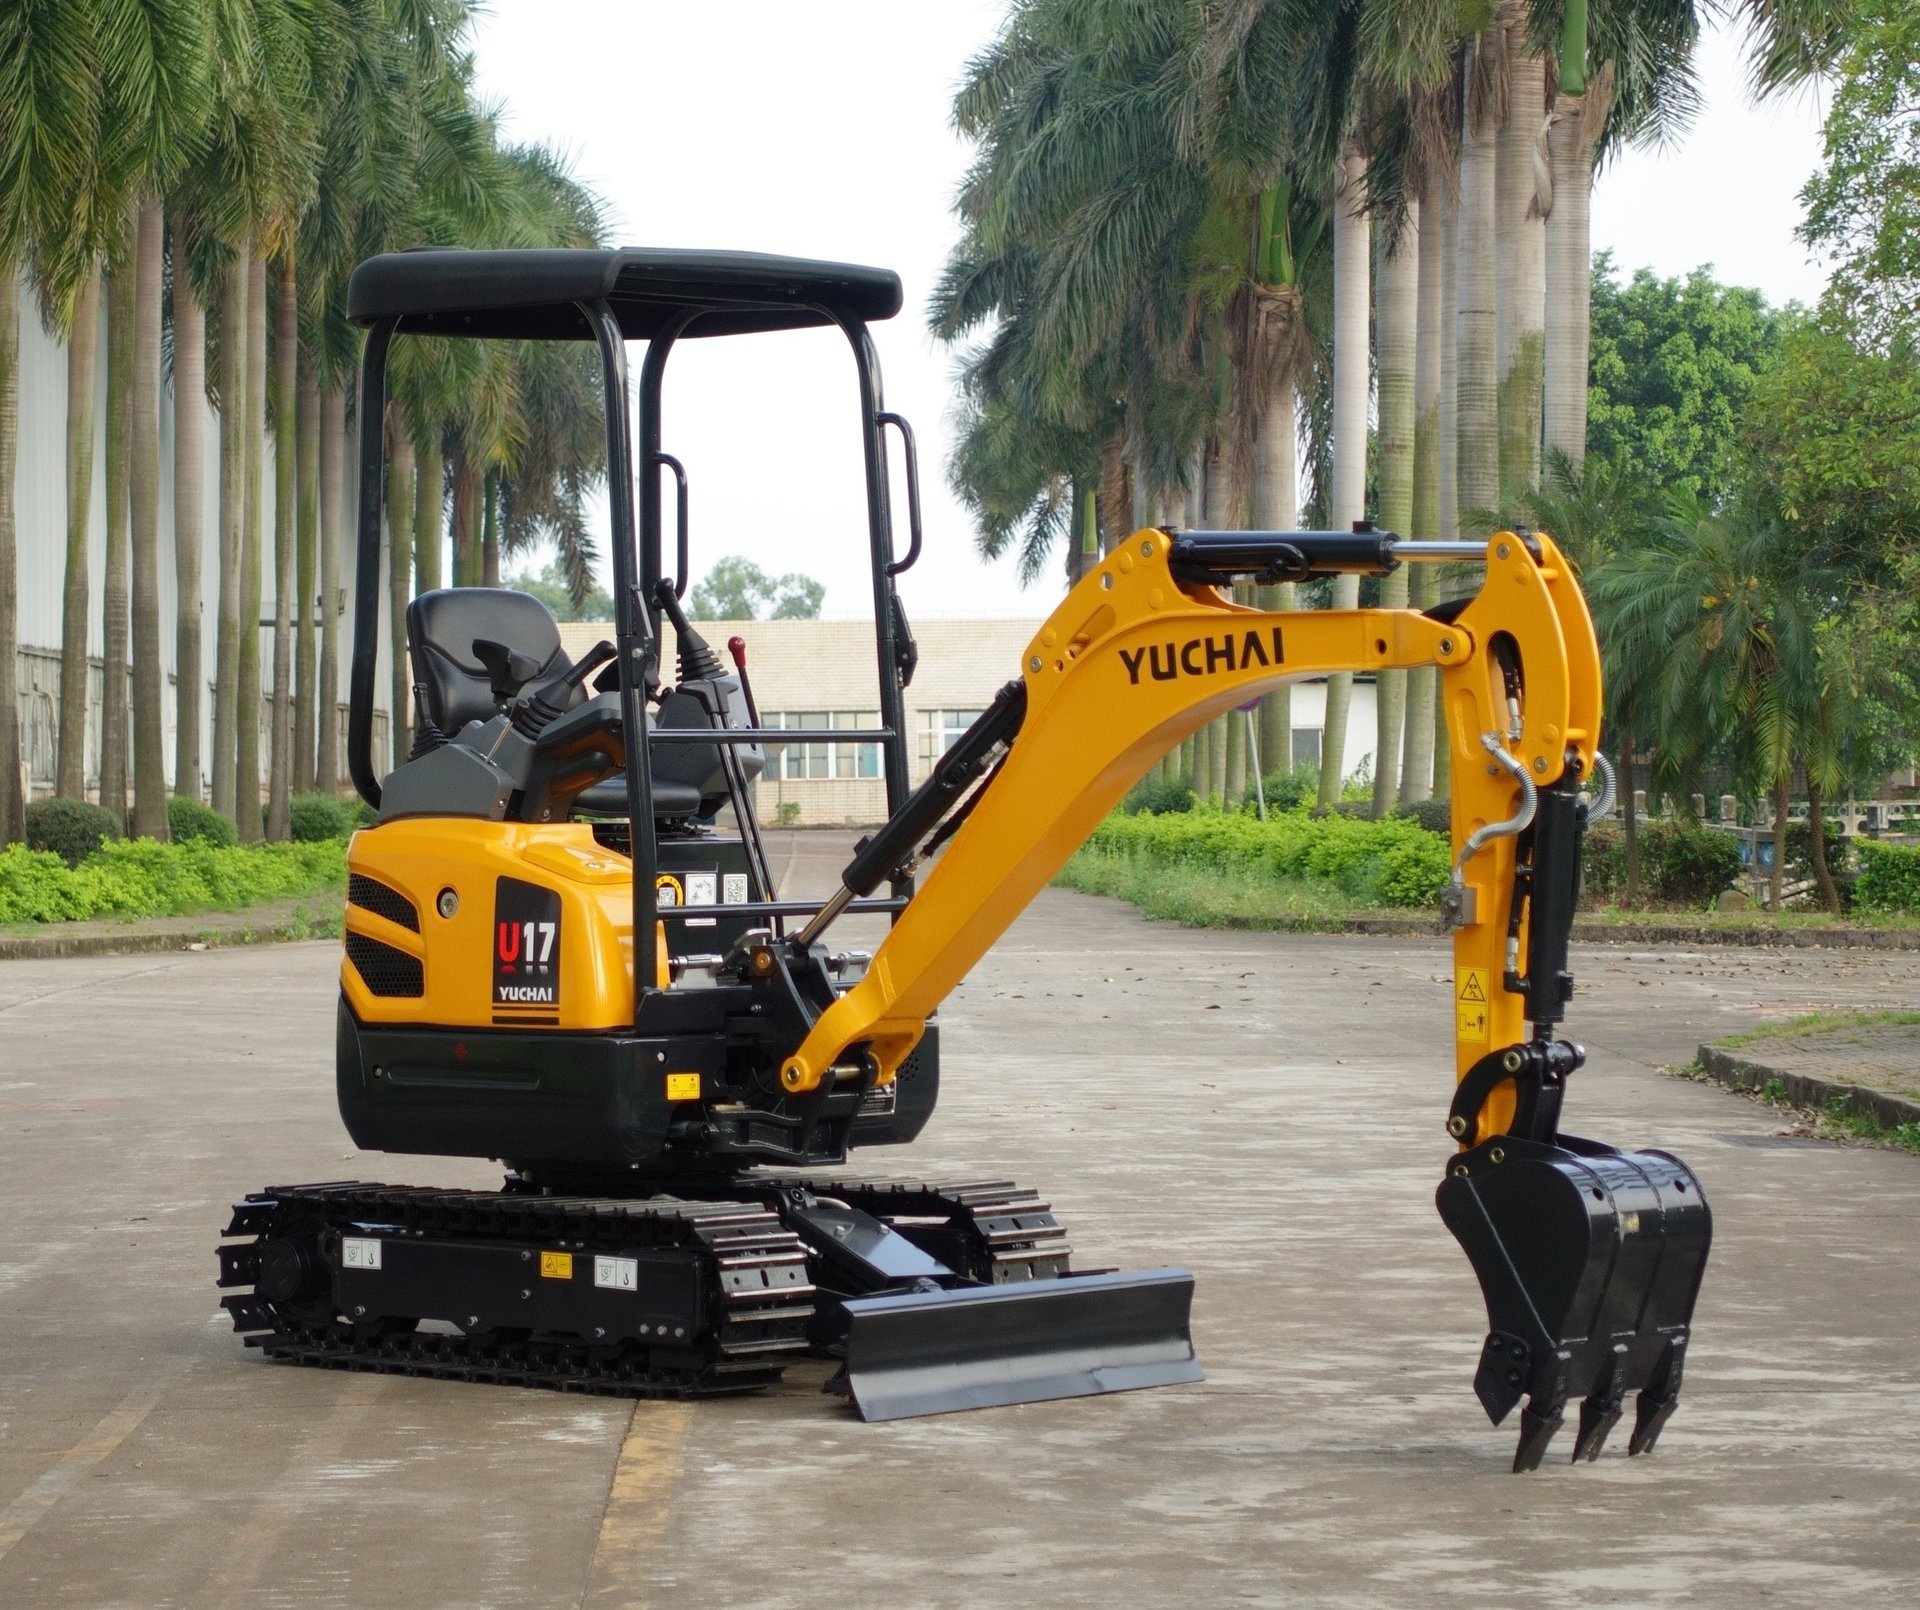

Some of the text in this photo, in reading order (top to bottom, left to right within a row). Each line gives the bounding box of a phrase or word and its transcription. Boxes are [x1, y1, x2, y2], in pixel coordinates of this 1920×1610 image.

[1118, 627, 1284, 685] YUCHAI
[499, 922, 556, 962] U17
[499, 986, 553, 1001] YUCHAI
